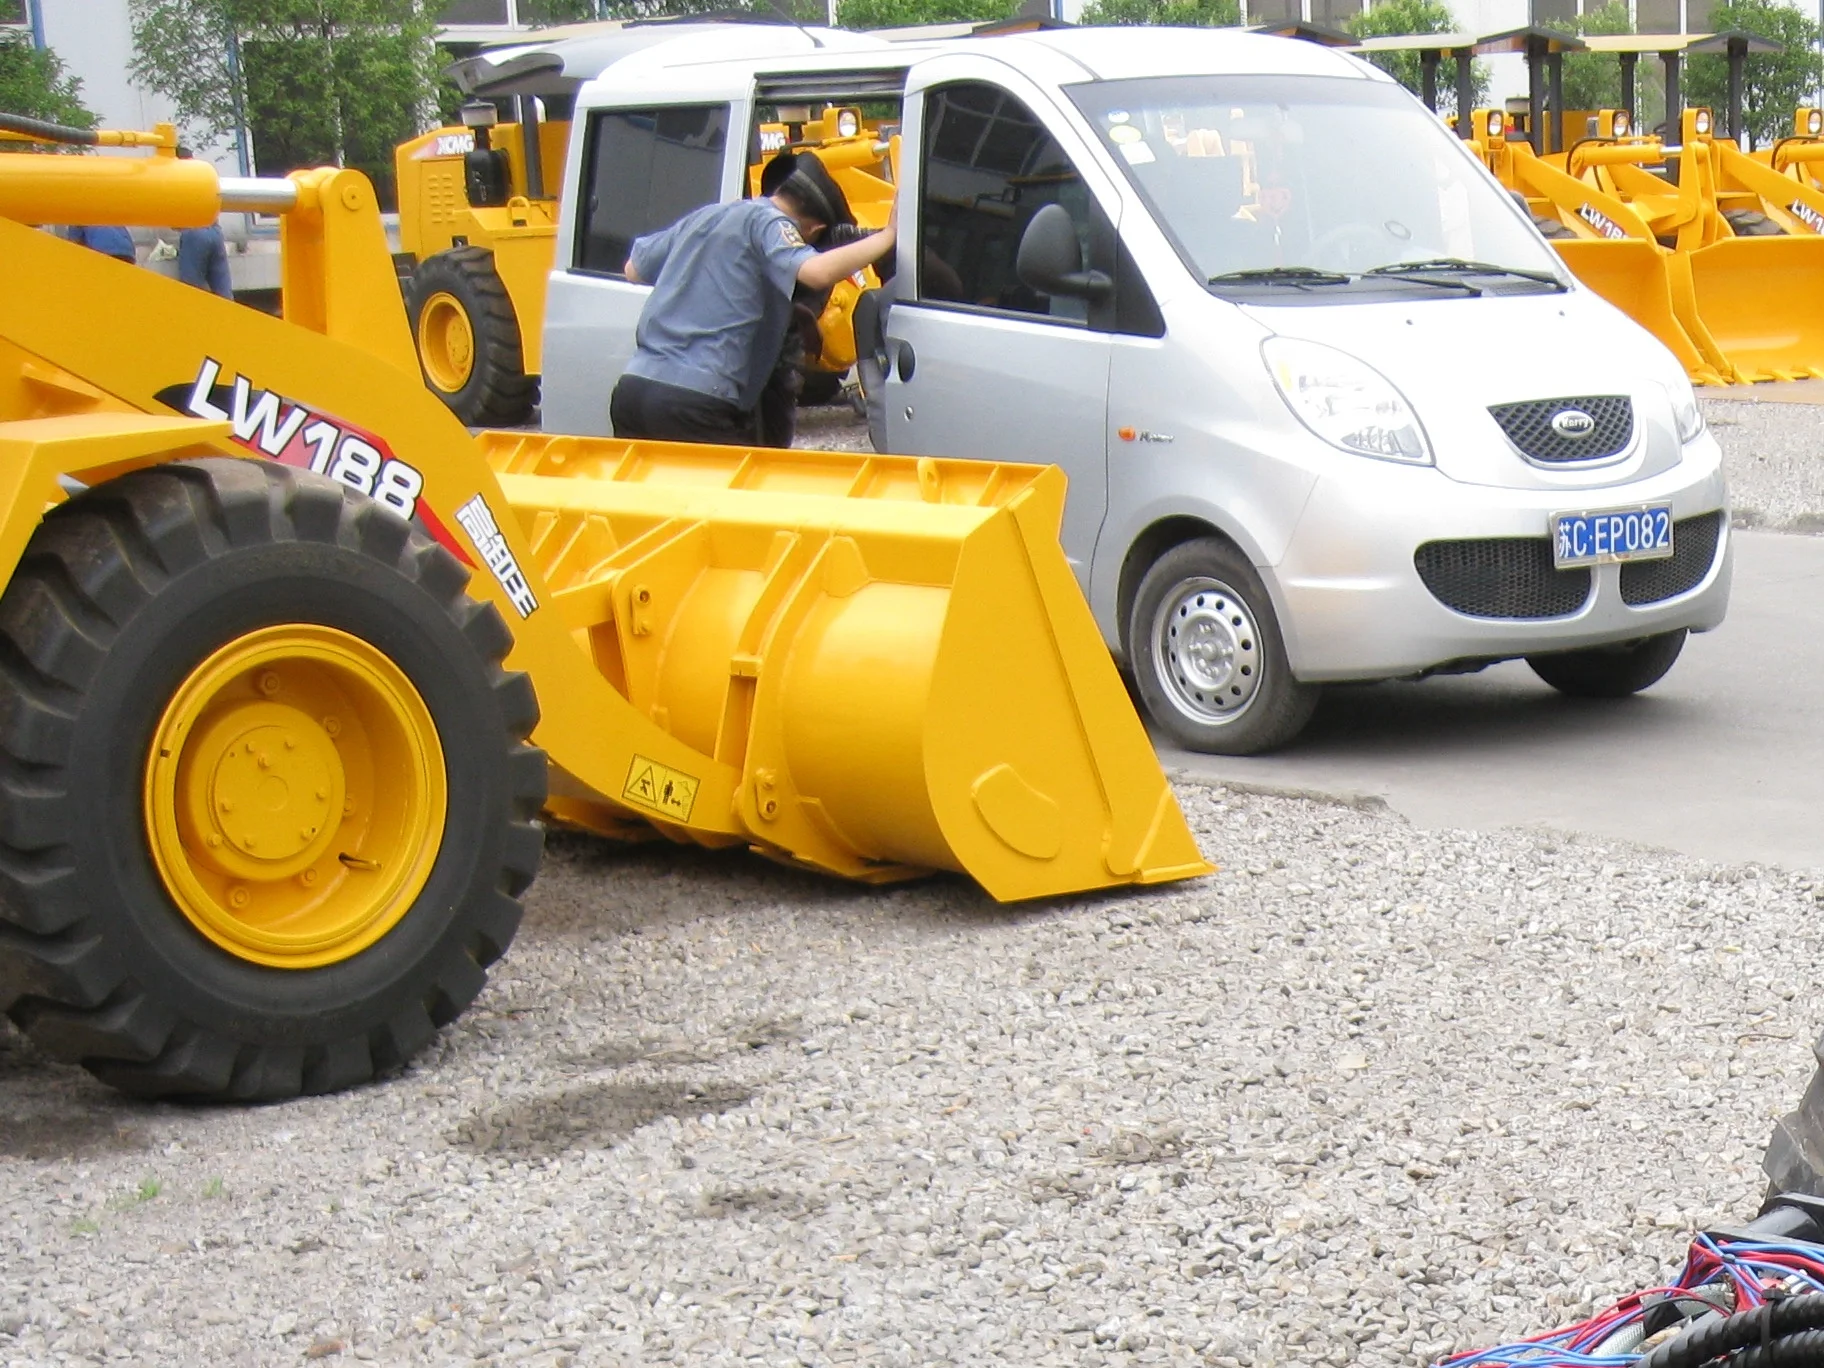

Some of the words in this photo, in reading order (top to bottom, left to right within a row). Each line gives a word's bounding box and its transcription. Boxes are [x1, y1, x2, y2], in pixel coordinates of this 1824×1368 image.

[436, 134, 474, 155] XCMG
[1580, 202, 1629, 239] LW18
[187, 356, 424, 520] LW188
[456, 493, 539, 620] 高卸王
